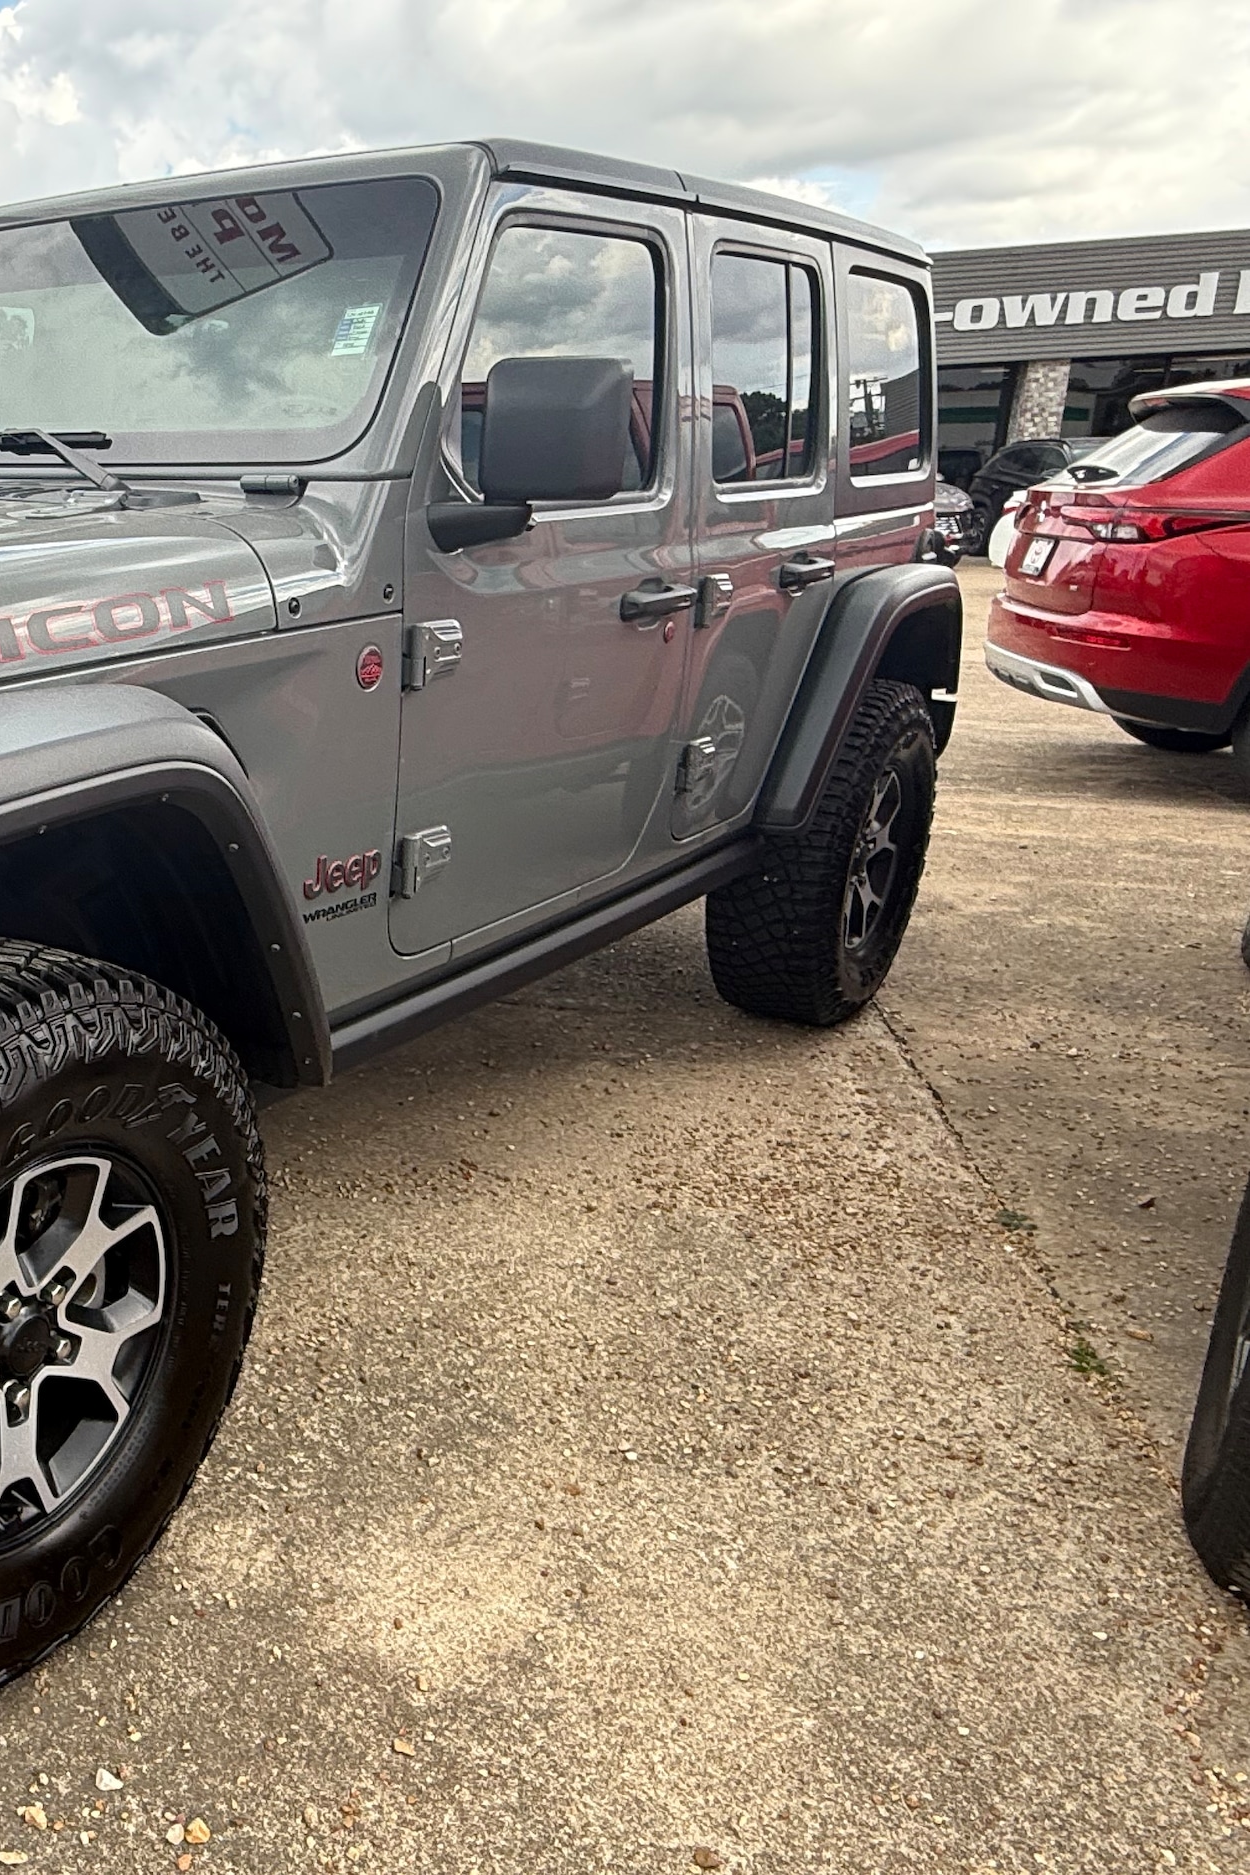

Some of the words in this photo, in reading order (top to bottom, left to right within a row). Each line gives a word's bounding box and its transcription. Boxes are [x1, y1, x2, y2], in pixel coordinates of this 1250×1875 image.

[303, 848, 383, 901] Jeep
[302, 892, 377, 924] WRANGLER
[3, 1082, 239, 1240] GOODYEAR
